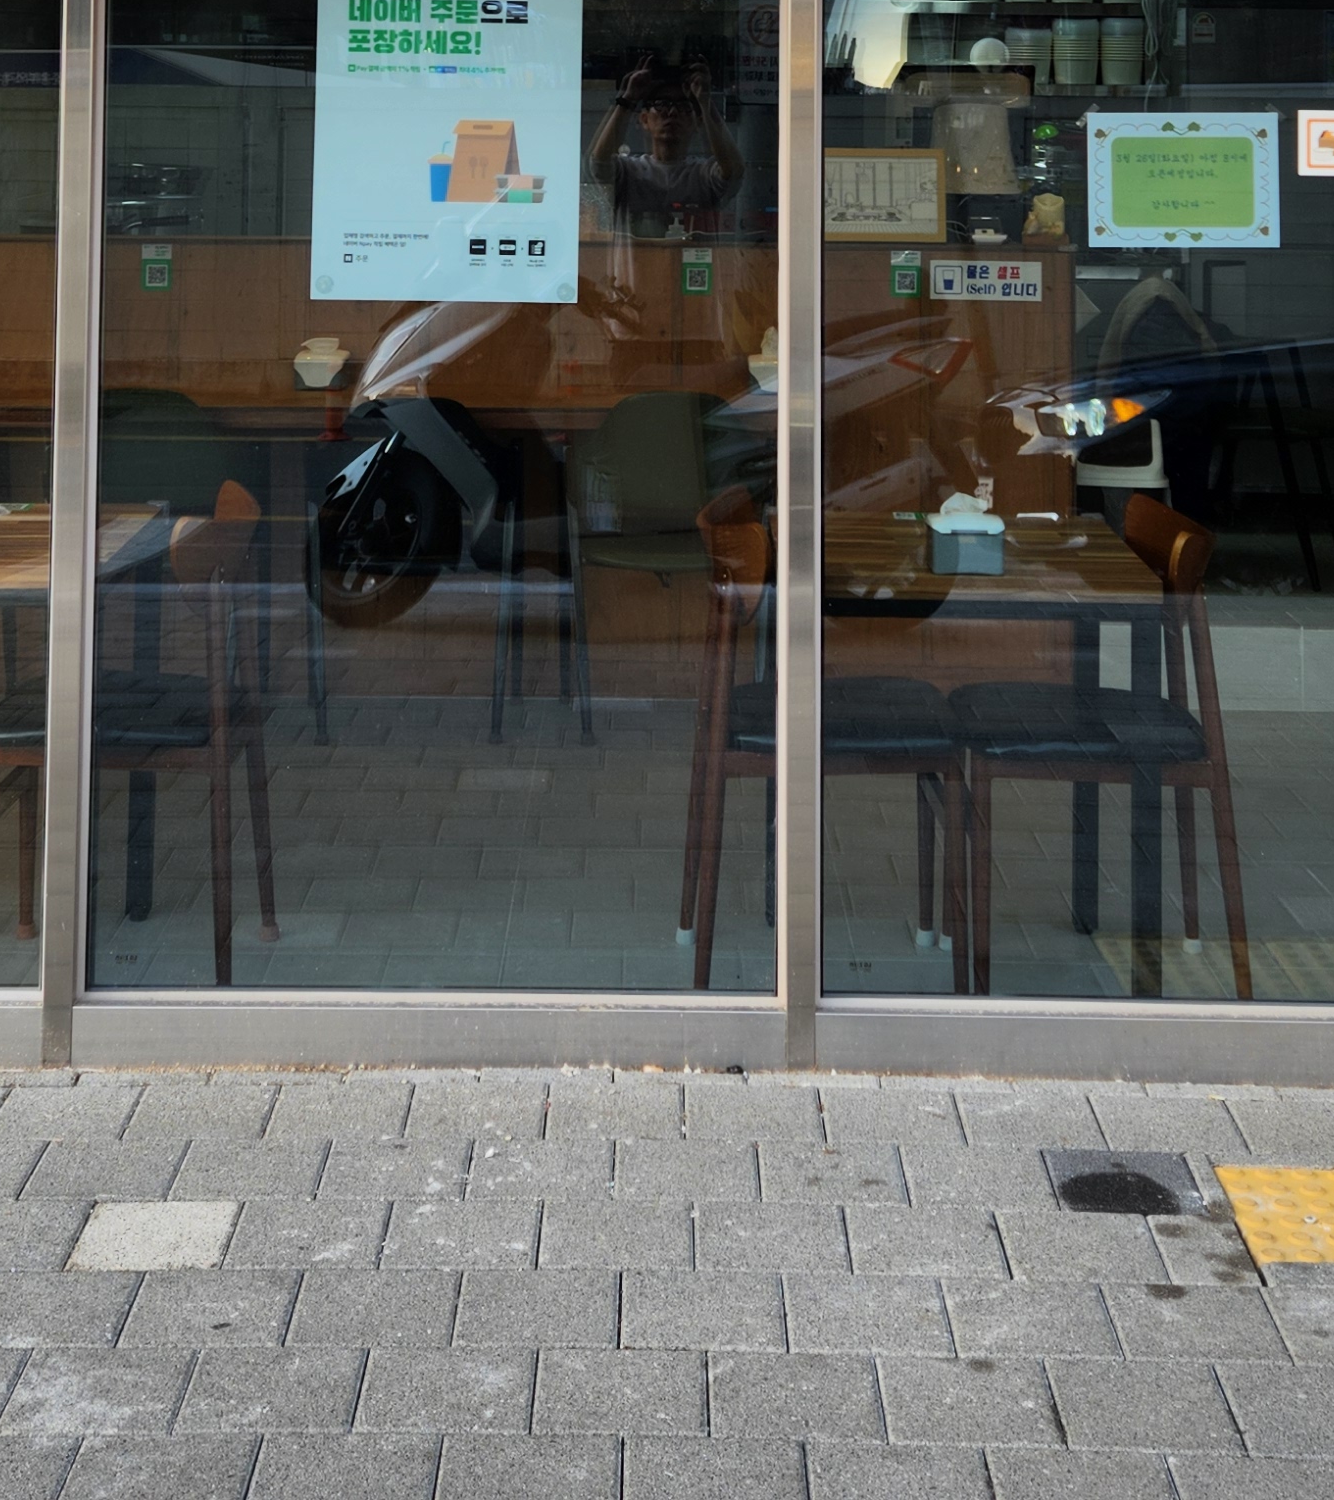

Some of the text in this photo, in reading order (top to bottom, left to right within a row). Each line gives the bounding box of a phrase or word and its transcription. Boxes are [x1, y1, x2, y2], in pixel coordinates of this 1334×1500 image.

[430, 0, 528, 24] 주문으로
[348, 29, 482, 55] 포장하세요!
[967, 264, 1021, 279] 물은 셀프
[966, 283, 1037, 297] (Self) 입니다
